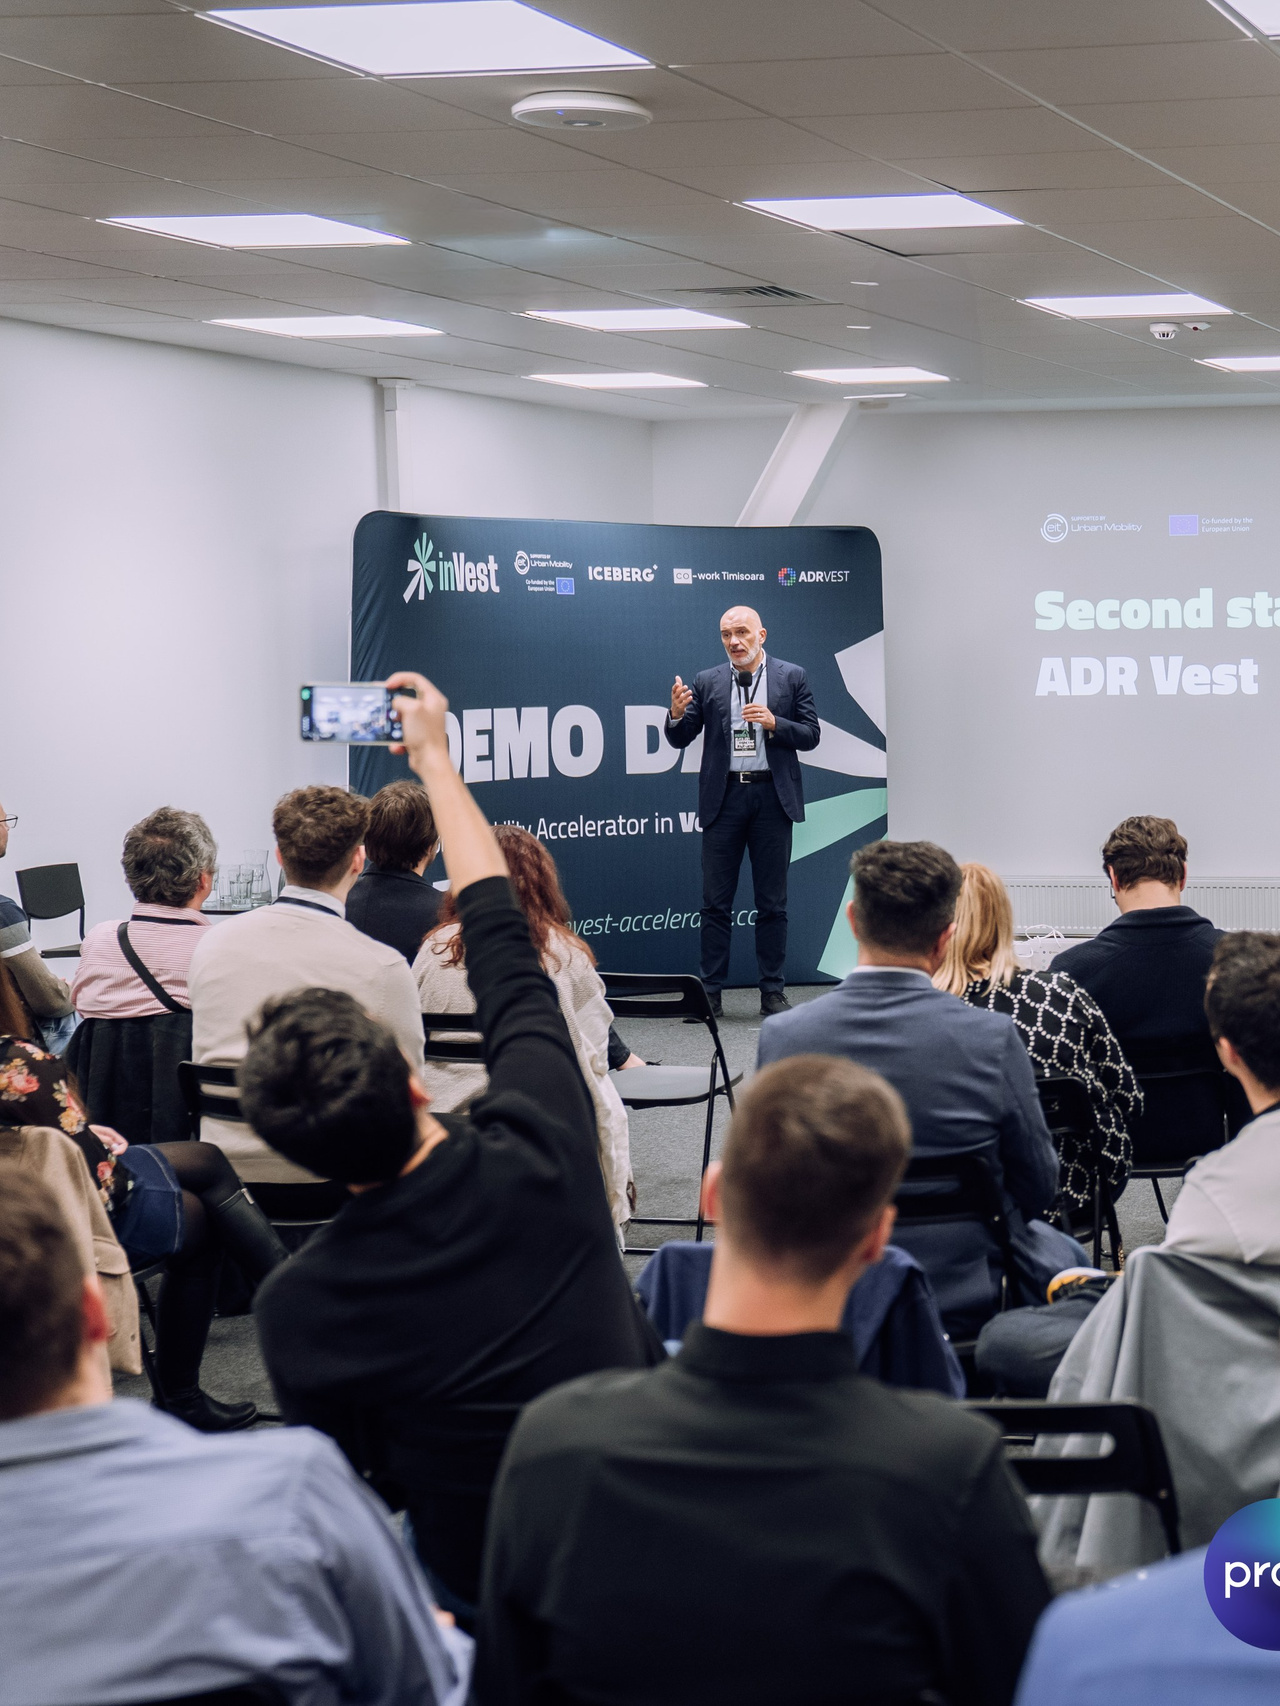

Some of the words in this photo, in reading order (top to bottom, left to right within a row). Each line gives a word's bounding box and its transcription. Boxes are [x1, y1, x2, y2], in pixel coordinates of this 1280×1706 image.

[1071, 522, 1102, 532] Urban
[1104, 522, 1142, 532] Mobility
[1202, 526, 1230, 534] European
[438, 552, 500, 593] inVest
[722, 572, 764, 581] Timisoara
[798, 571, 850, 582] ADRVEST
[1035, 587, 1214, 631] Second
[1035, 656, 1138, 696] ADR
[1150, 656, 1259, 696] Vest
[536, 814, 648, 840] Accelerator
[654, 812, 673, 834] in
